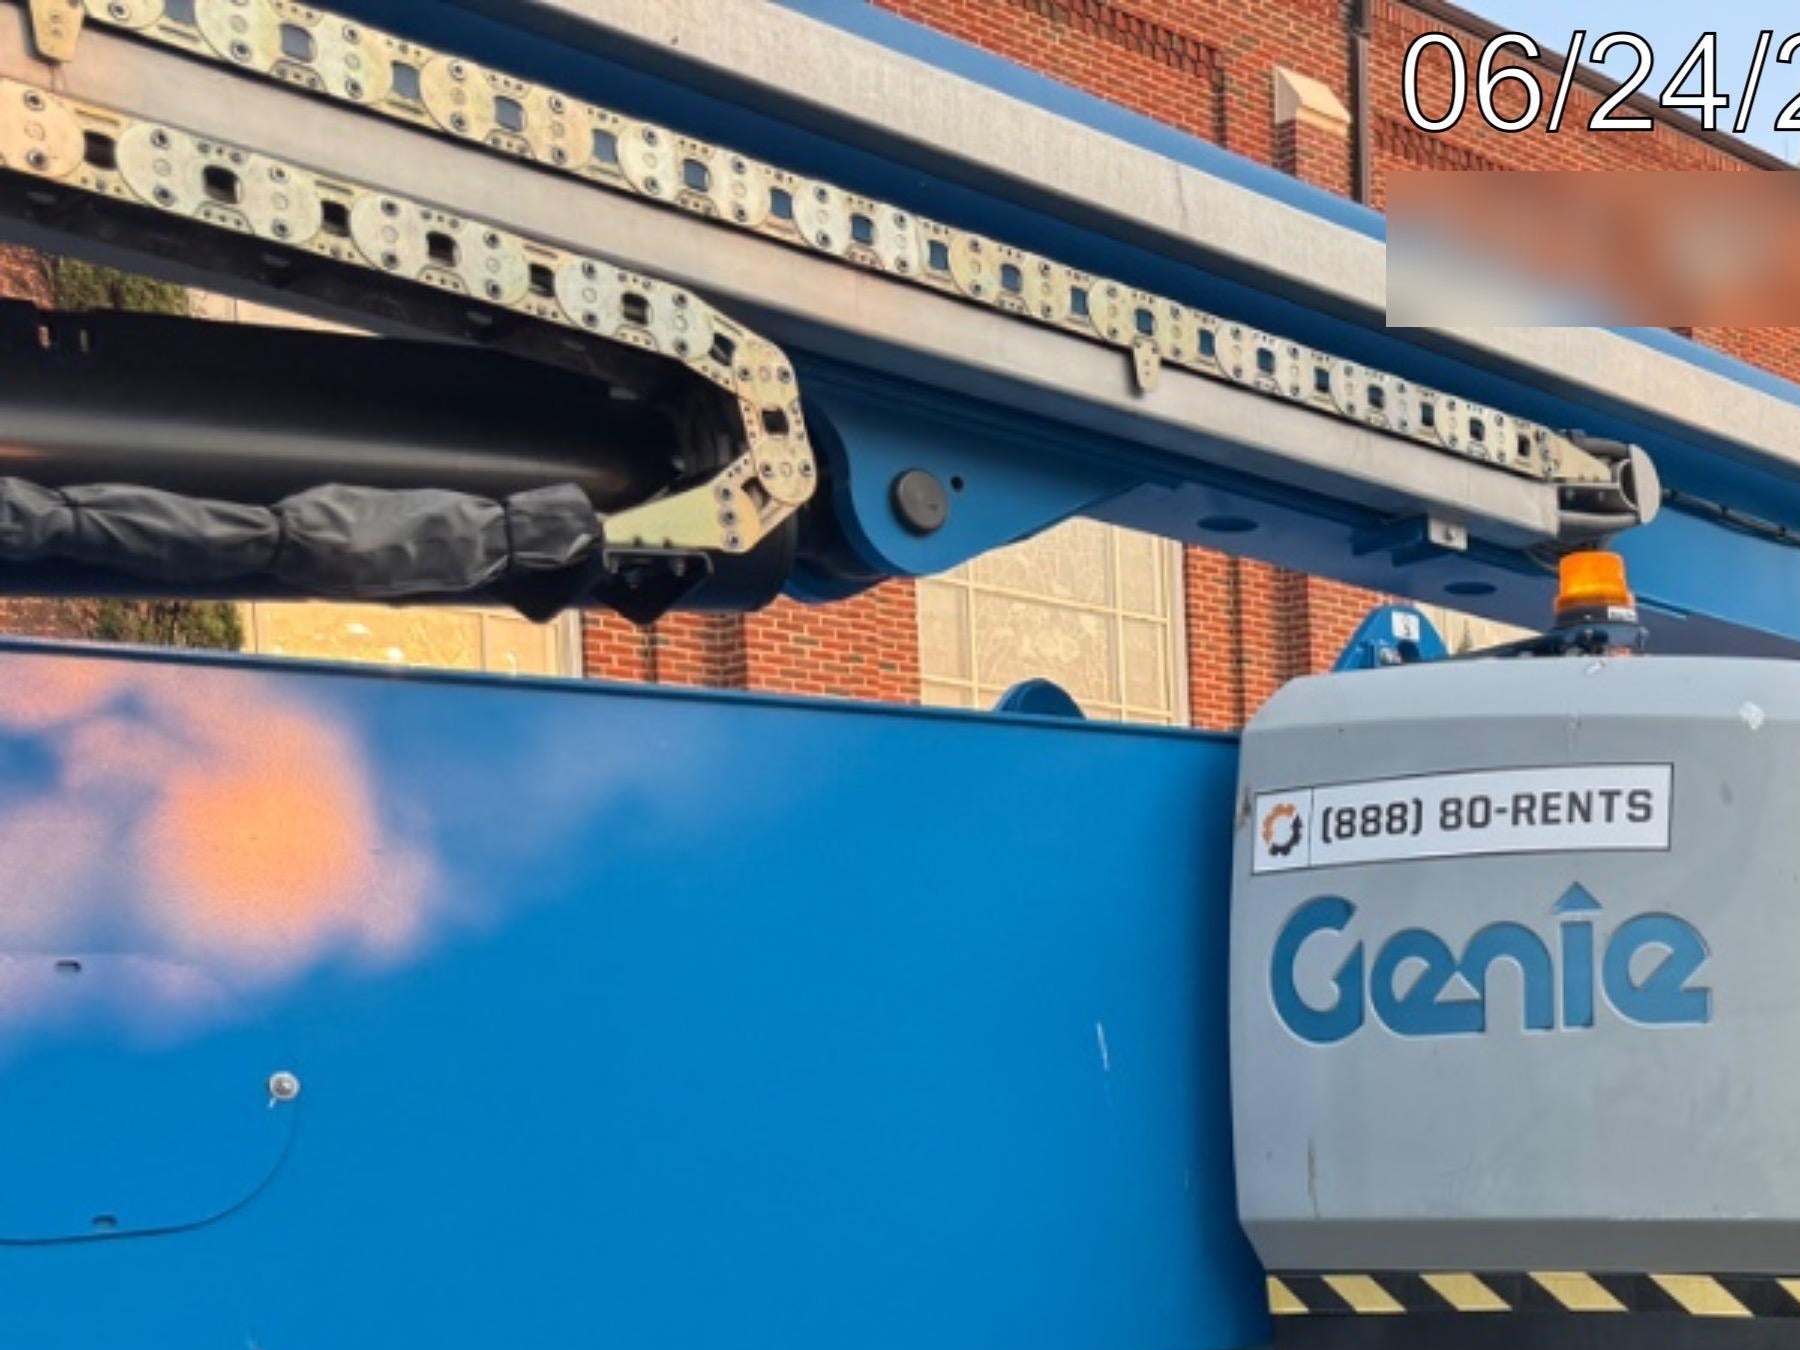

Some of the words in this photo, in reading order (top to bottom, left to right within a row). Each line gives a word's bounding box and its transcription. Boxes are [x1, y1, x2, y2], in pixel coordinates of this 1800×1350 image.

[1320, 798, 1424, 843] (888)
[1440, 787, 1654, 831] 80-RENTS
[1269, 882, 1711, 1046] Genie
